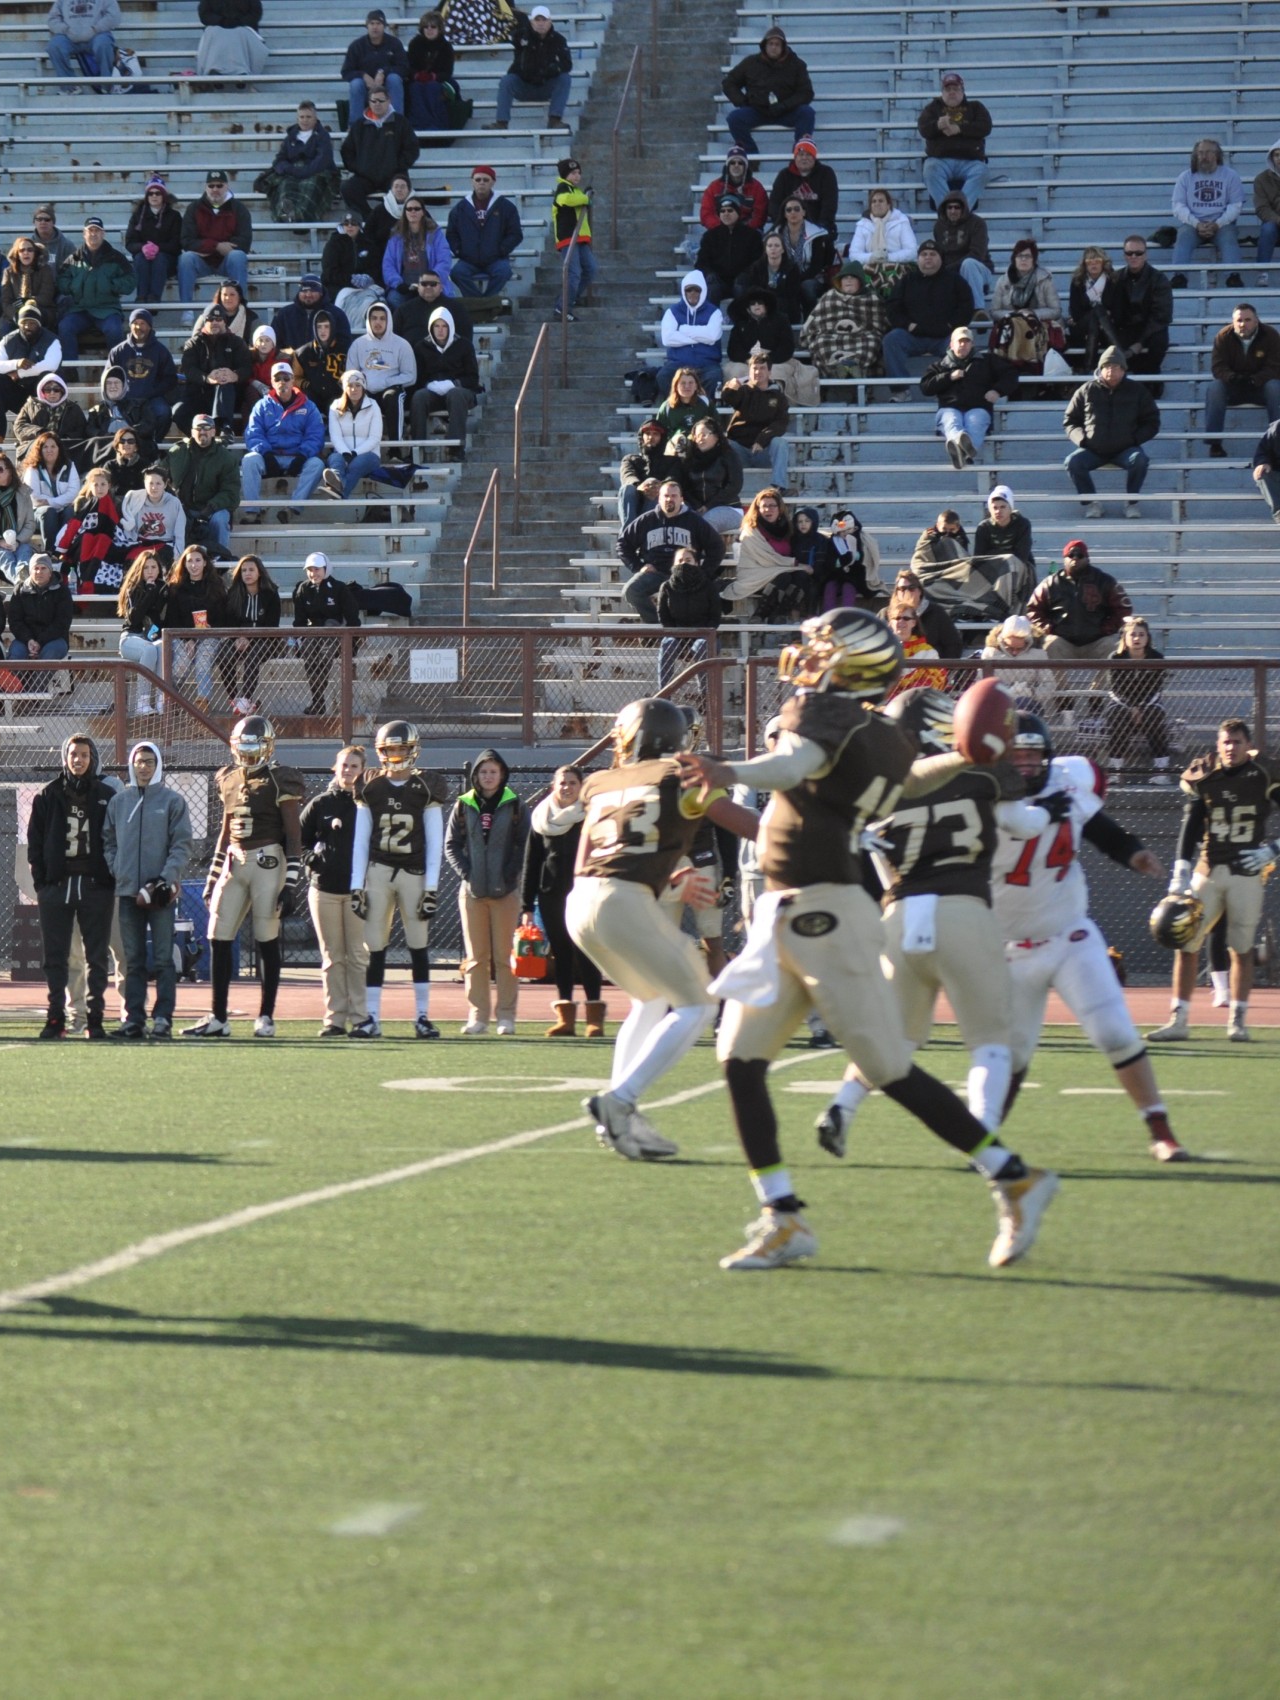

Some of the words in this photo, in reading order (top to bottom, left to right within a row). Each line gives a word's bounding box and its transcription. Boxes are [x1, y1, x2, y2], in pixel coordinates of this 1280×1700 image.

[413, 666, 455, 680] SMOKING
[426, 652, 441, 665] NO
[71, 805, 85, 818] BC
[387, 797, 402, 810] BC
[65, 816, 91, 857] 31
[379, 813, 414, 854] 12
[890, 798, 984, 875] 73
[1210, 805, 1257, 843] 46
[1005, 820, 1075, 887] 74
